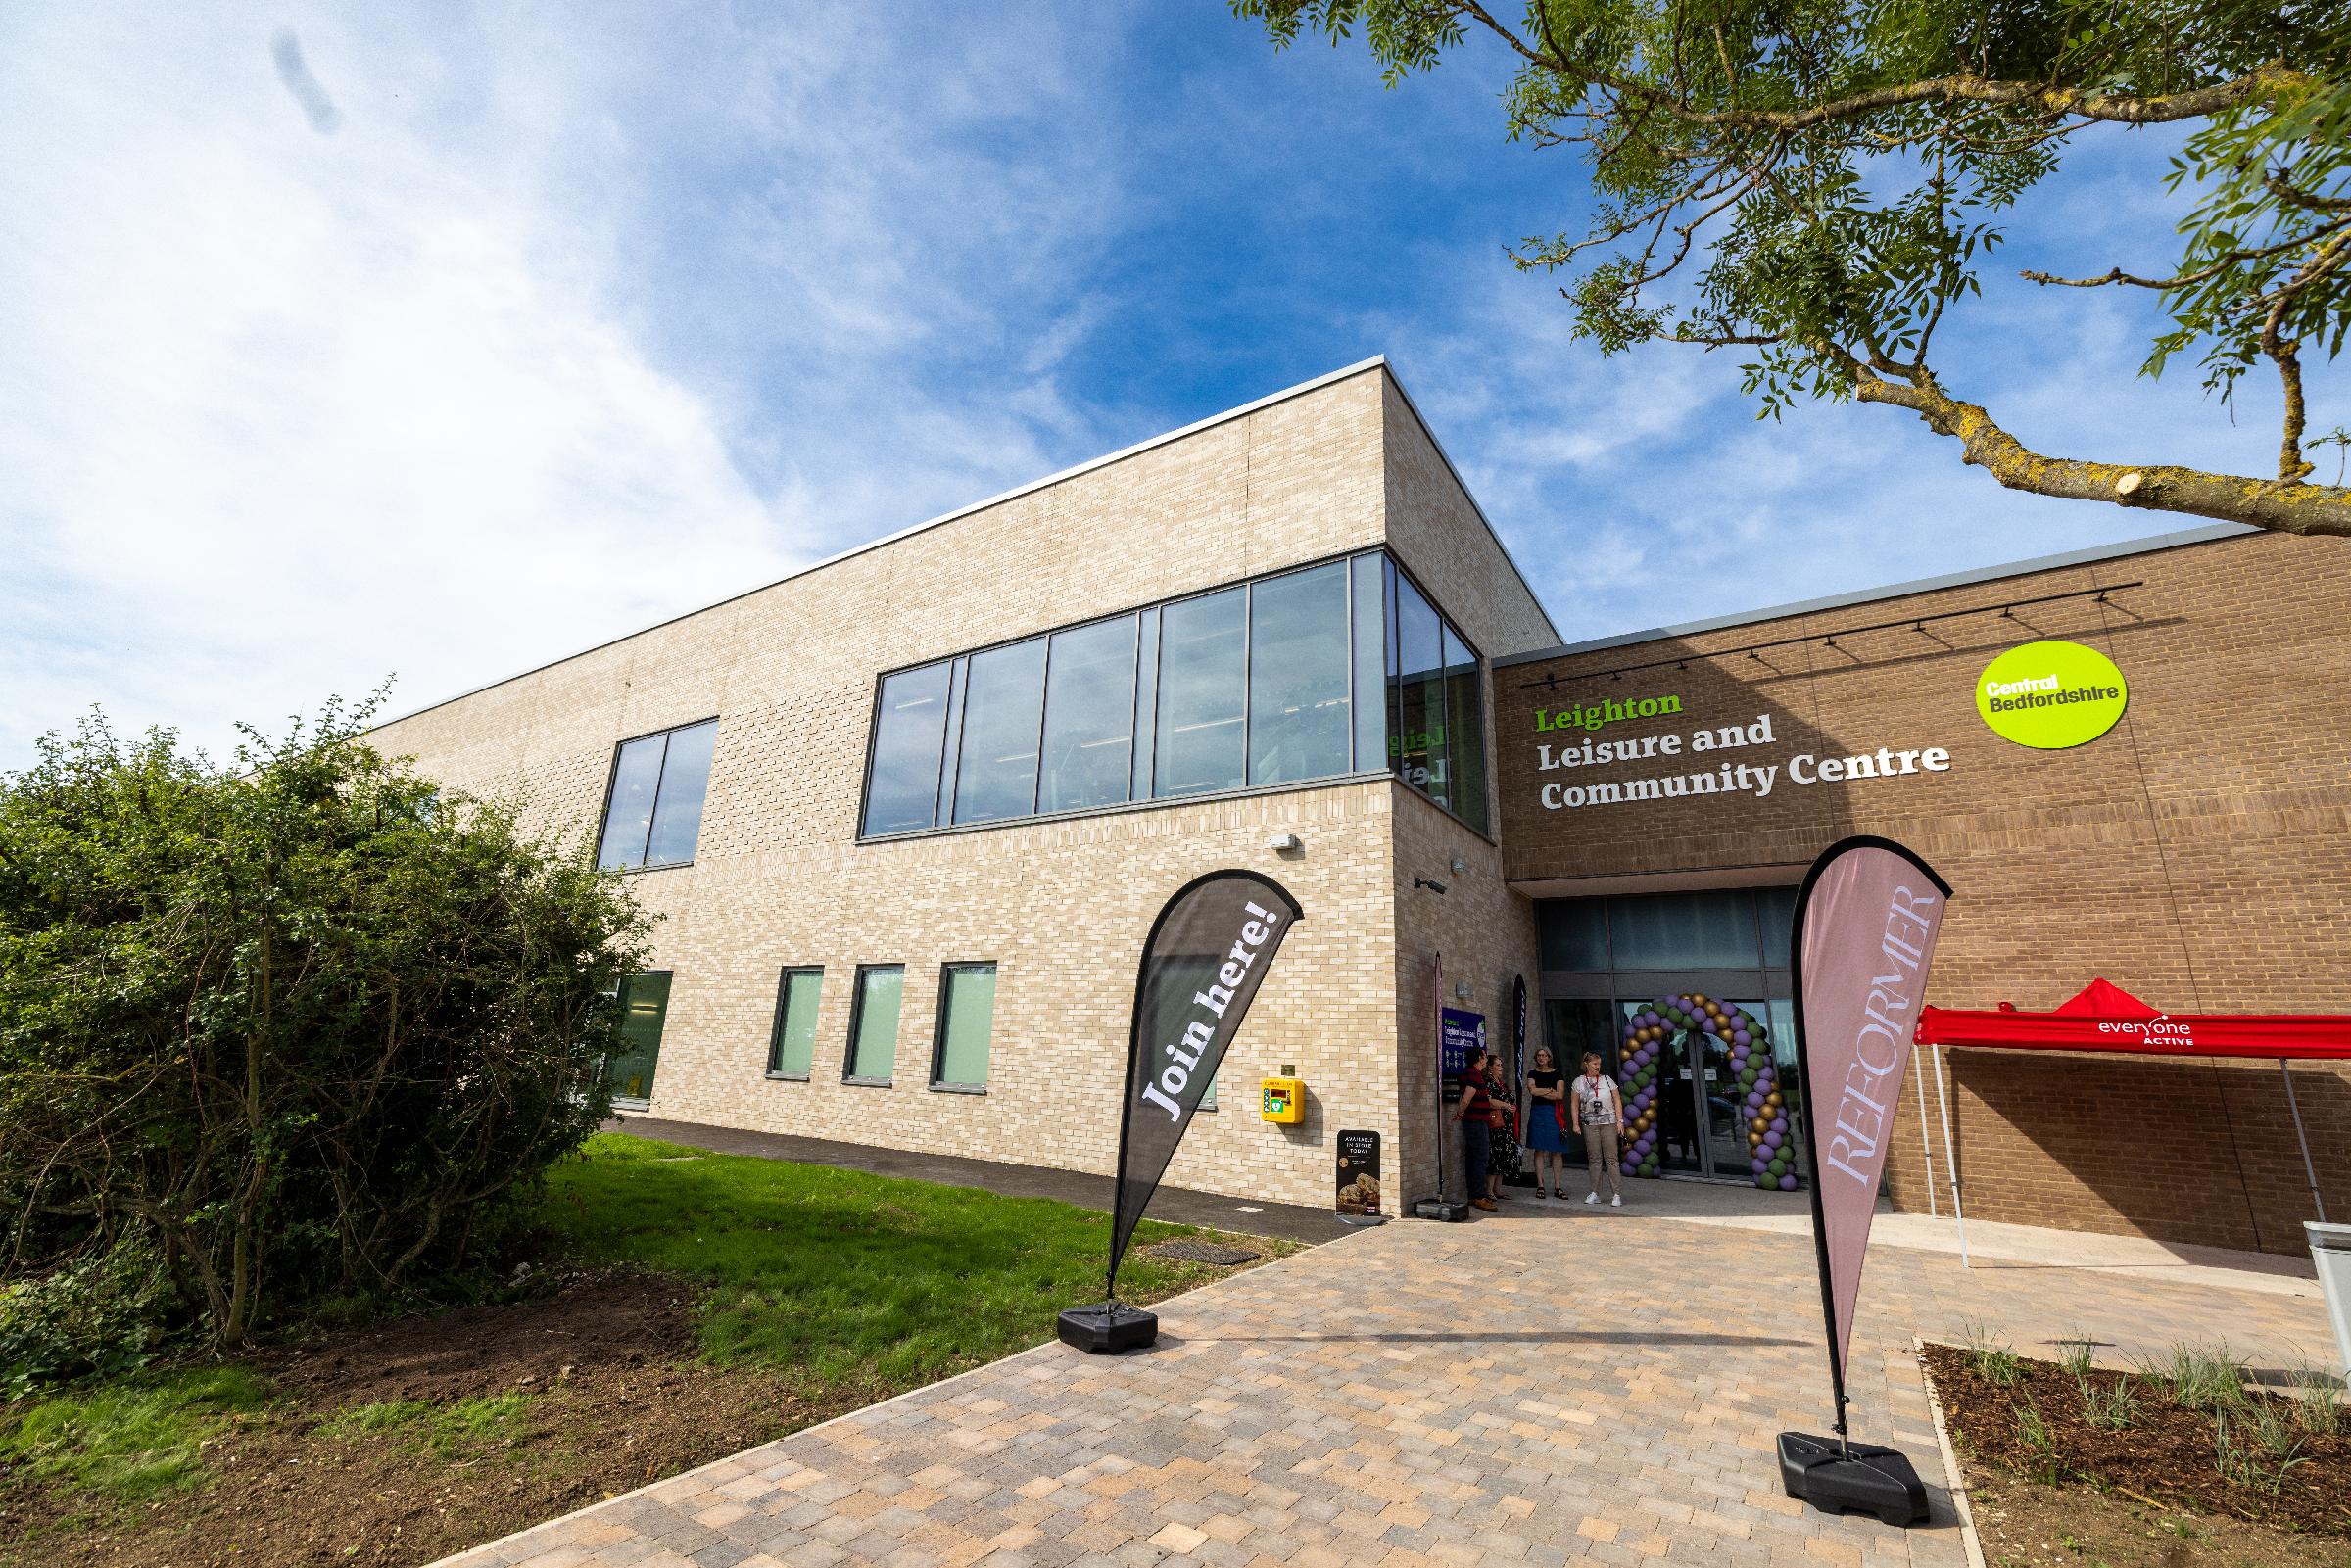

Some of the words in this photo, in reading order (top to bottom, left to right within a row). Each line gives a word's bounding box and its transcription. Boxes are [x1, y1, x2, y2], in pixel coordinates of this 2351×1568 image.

[1986, 674, 2059, 697] Central
[1990, 686, 2120, 713] Bedfordshire
[1535, 694, 1683, 733] Leighton
[1537, 735, 1683, 771] Leisure
[1692, 713, 1777, 753] and
[1541, 762, 1779, 810] Community
[1788, 746, 1951, 784] Centre
[1141, 1021, 1216, 1123] Join
[1193, 900, 1277, 1019] here!
[2098, 1016, 2191, 1036] everyone
[1827, 885, 1936, 1187] REFORMER
[2144, 1037, 2194, 1046] ACTIVE
